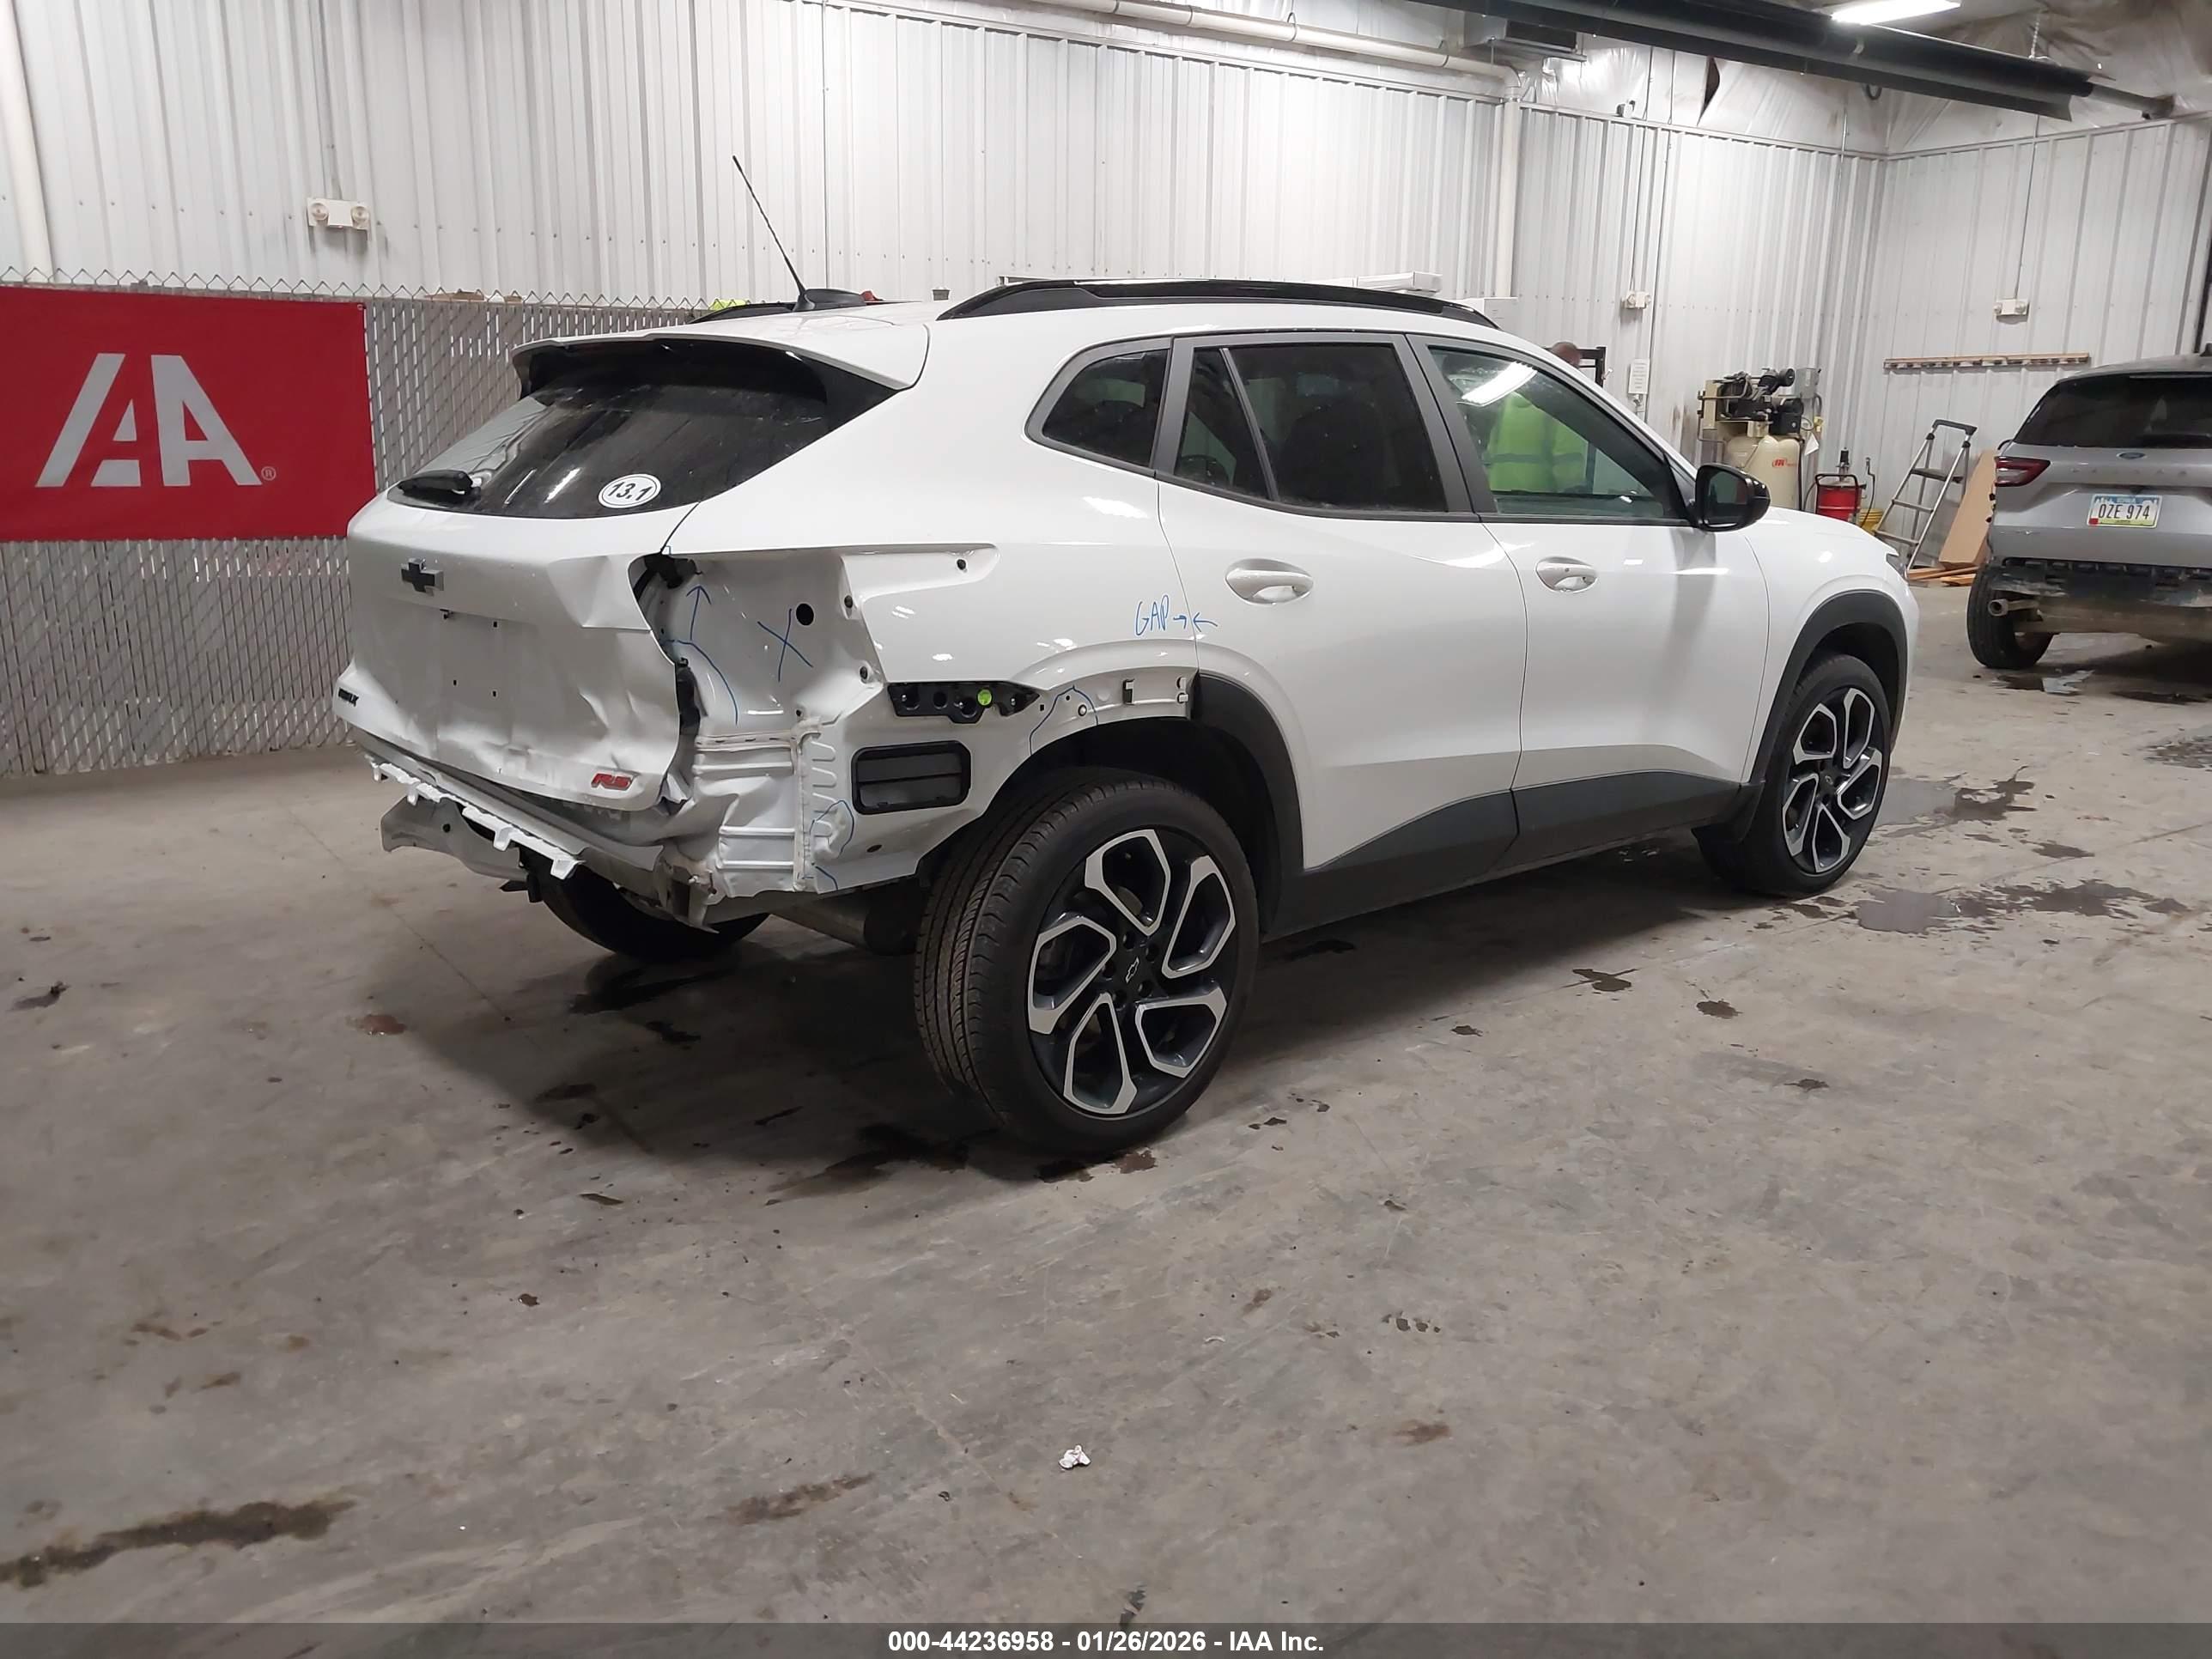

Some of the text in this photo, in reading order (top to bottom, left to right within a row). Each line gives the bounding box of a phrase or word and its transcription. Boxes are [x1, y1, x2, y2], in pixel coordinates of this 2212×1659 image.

[607, 482, 653, 501] 13.1
[2098, 504, 2150, 520] OZE 974
[1135, 594, 1170, 636] GAP
[591, 773, 633, 791] RS
